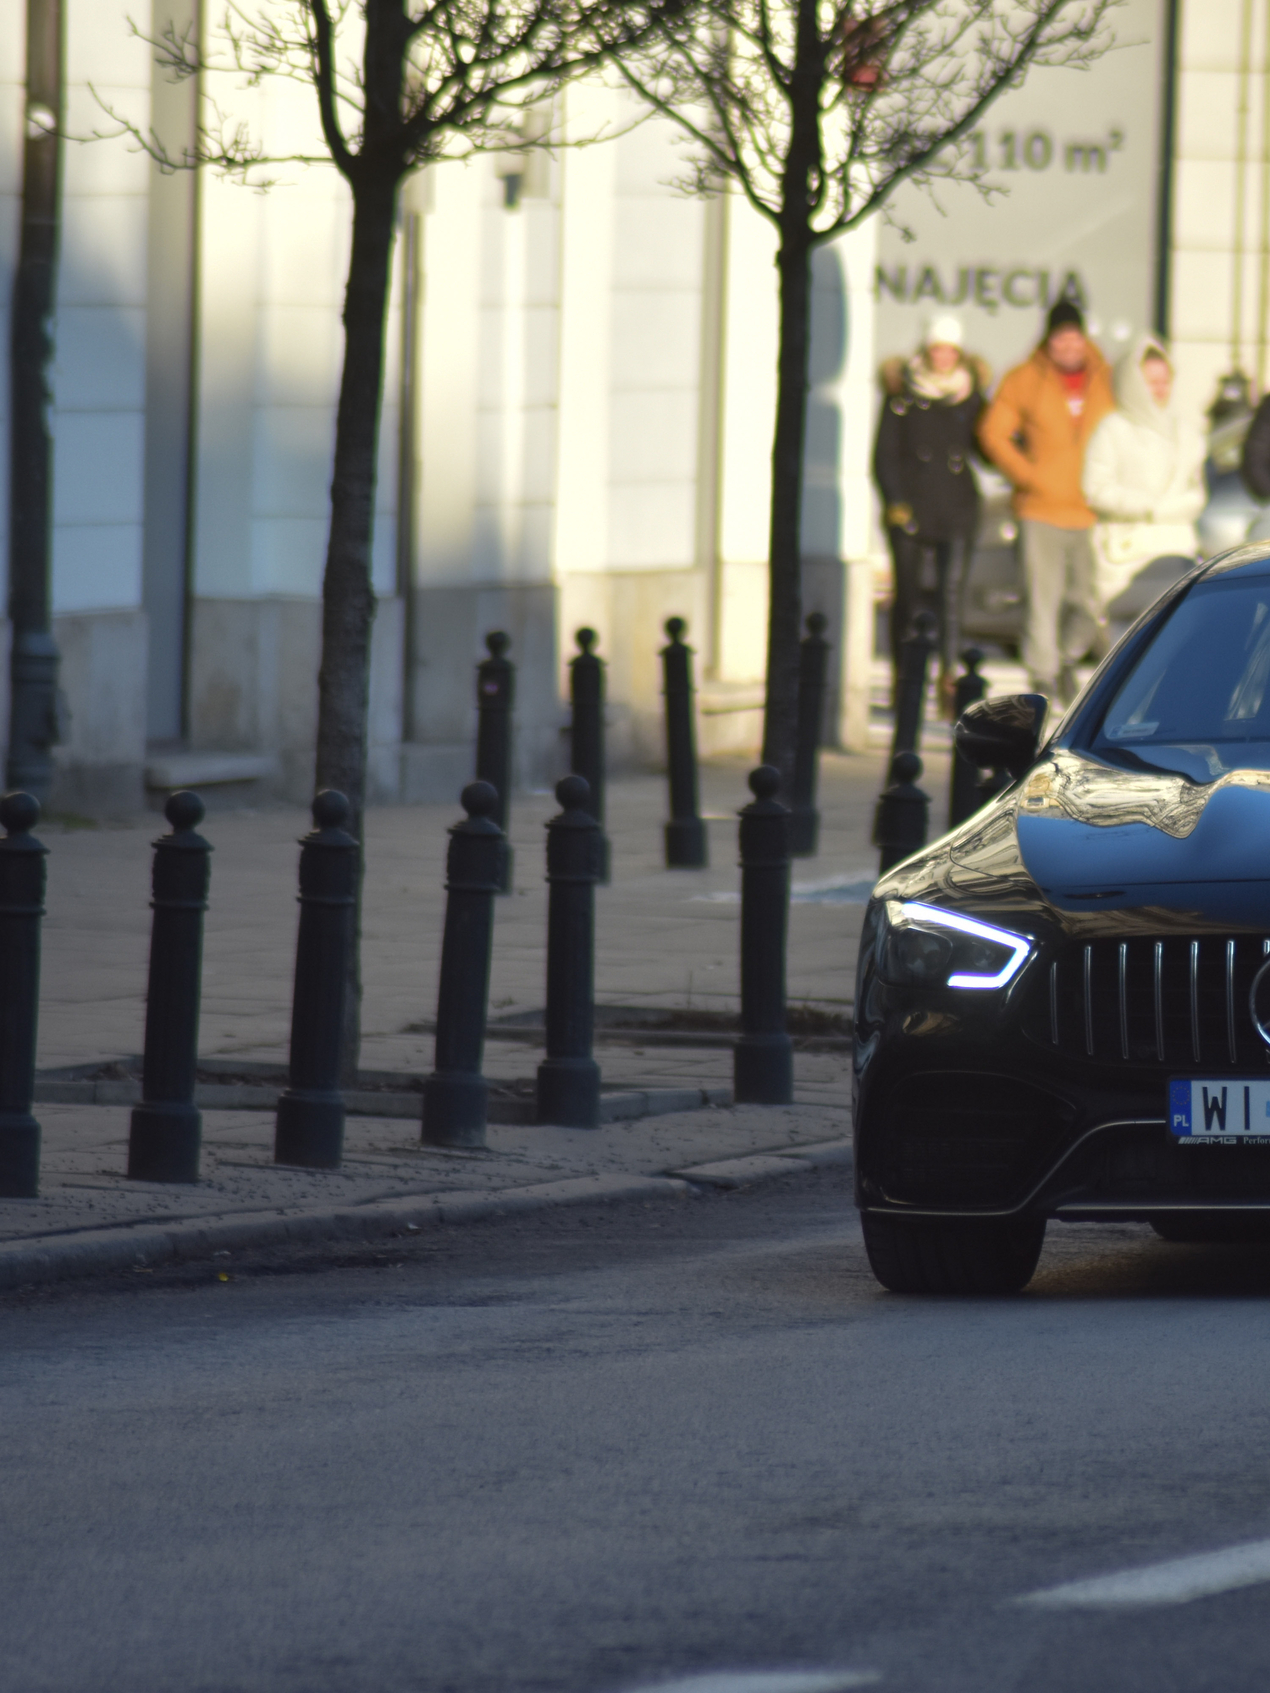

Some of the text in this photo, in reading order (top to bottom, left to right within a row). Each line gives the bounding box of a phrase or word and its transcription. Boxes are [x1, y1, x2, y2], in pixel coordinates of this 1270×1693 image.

[1202, 1086, 1251, 1131] WI
[1173, 1114, 1190, 1127] PL
[1196, 1136, 1237, 1145] AMG
